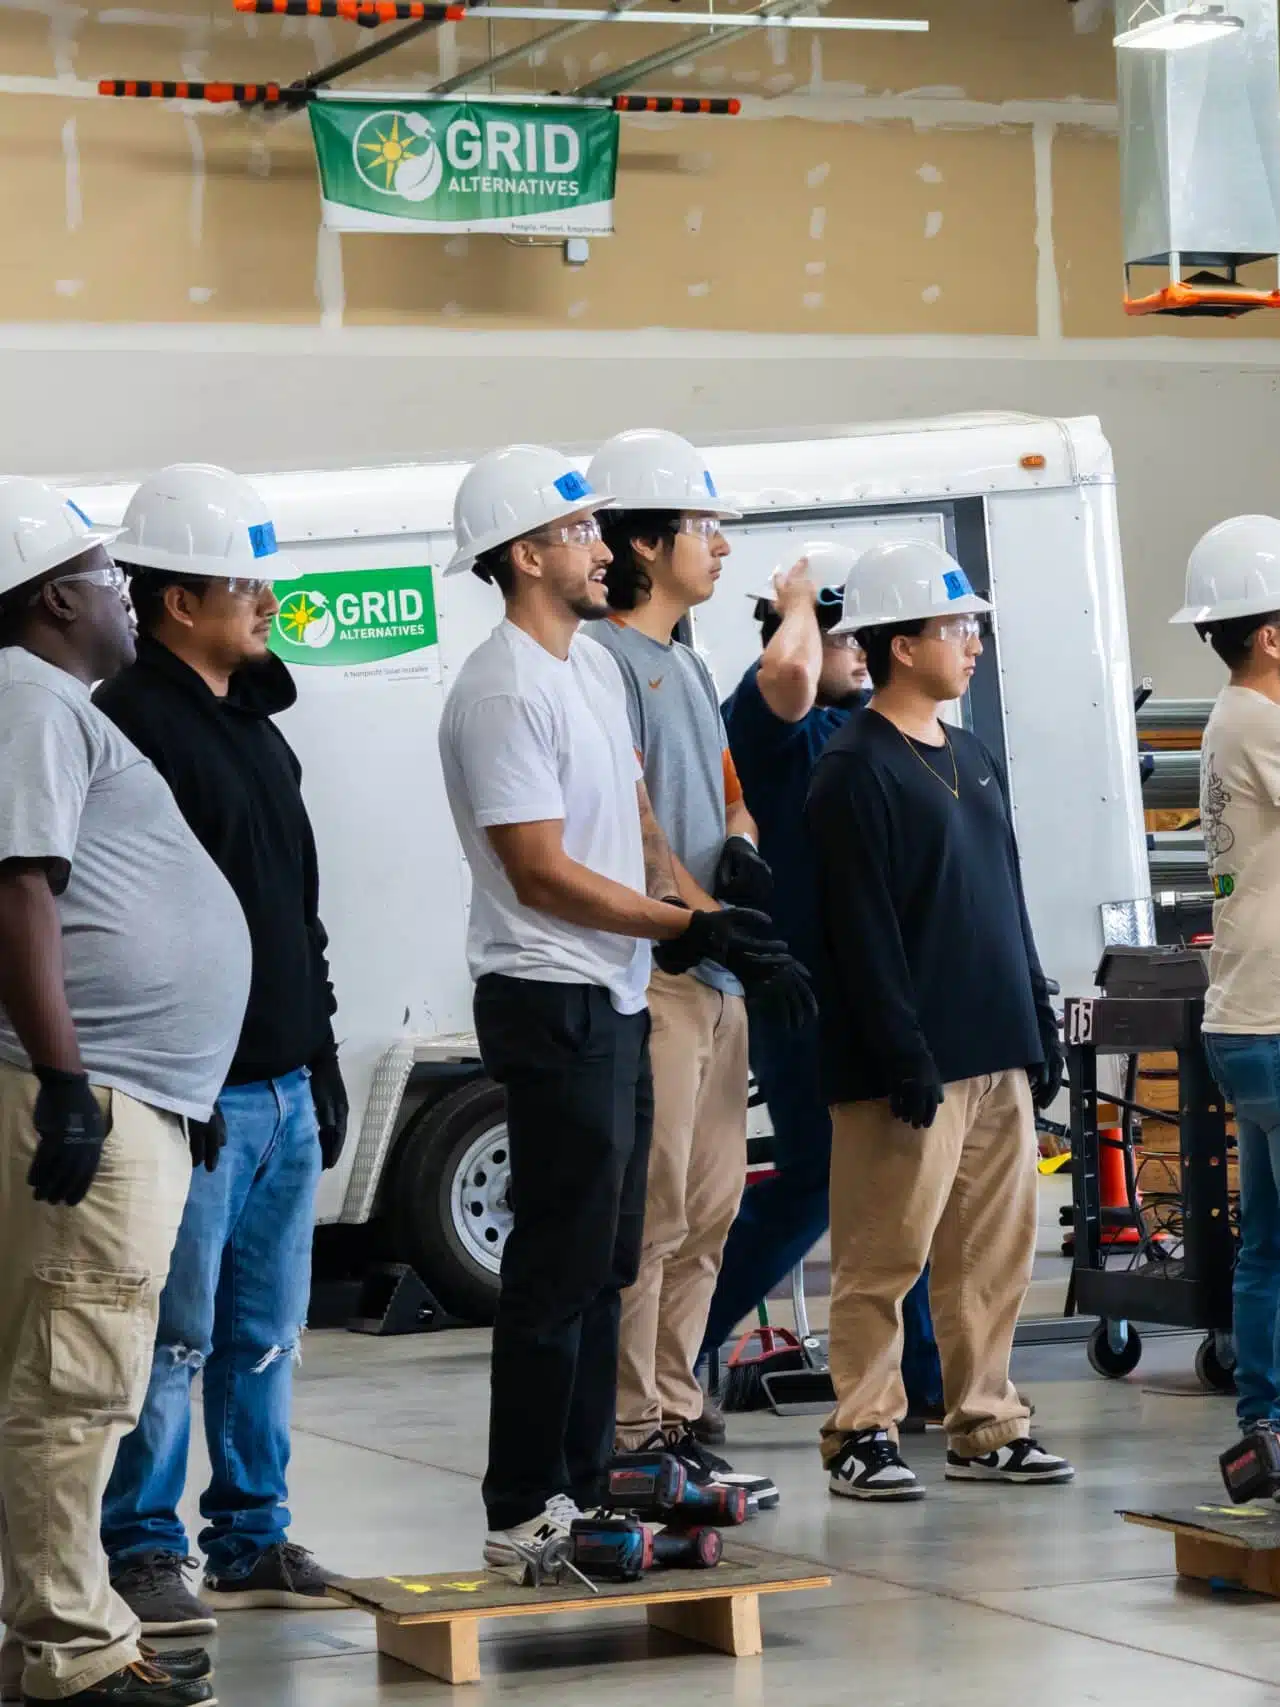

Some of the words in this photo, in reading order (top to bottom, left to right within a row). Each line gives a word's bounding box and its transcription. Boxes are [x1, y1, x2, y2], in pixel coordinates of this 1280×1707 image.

[446, 119, 580, 174] GRID
[448, 176, 579, 196] ALTERNATIVES
[336, 589, 423, 626] GRID
[339, 624, 425, 641] ALTERNATIVES
[1073, 1002, 1091, 1042] 15
